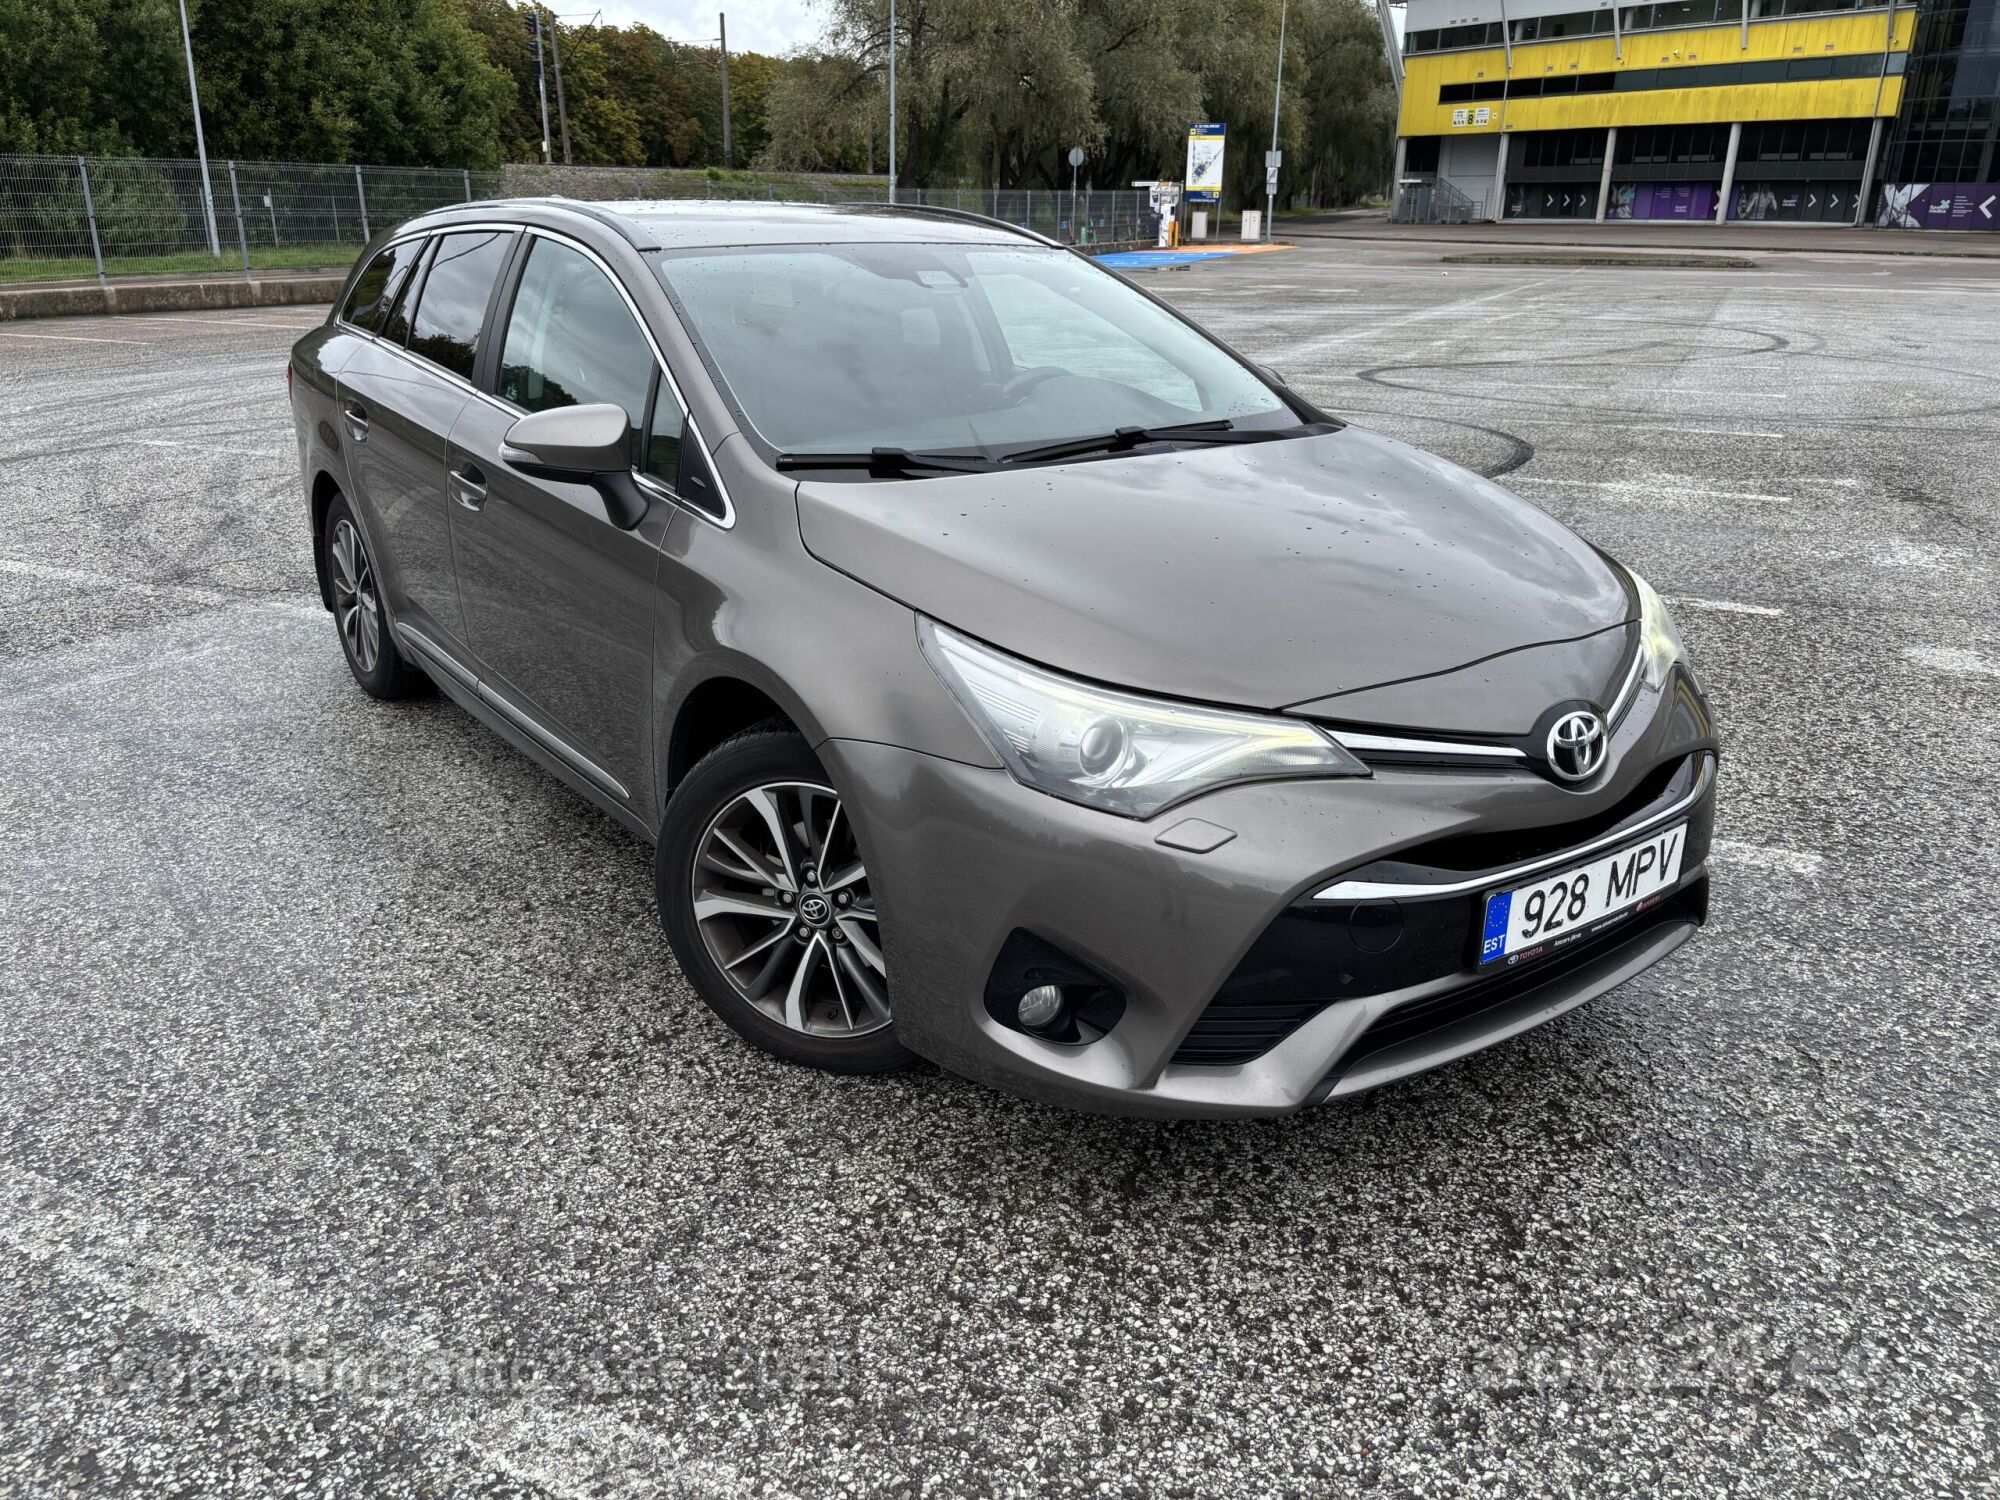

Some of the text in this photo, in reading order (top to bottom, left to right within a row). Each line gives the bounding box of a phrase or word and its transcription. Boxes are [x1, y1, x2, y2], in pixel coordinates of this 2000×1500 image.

[1467, 114, 1474, 125] 8
[1521, 833, 1679, 939] 928 MPV
[1483, 933, 1505, 954] EST
[1518, 946, 1543, 961] TOYOTA
